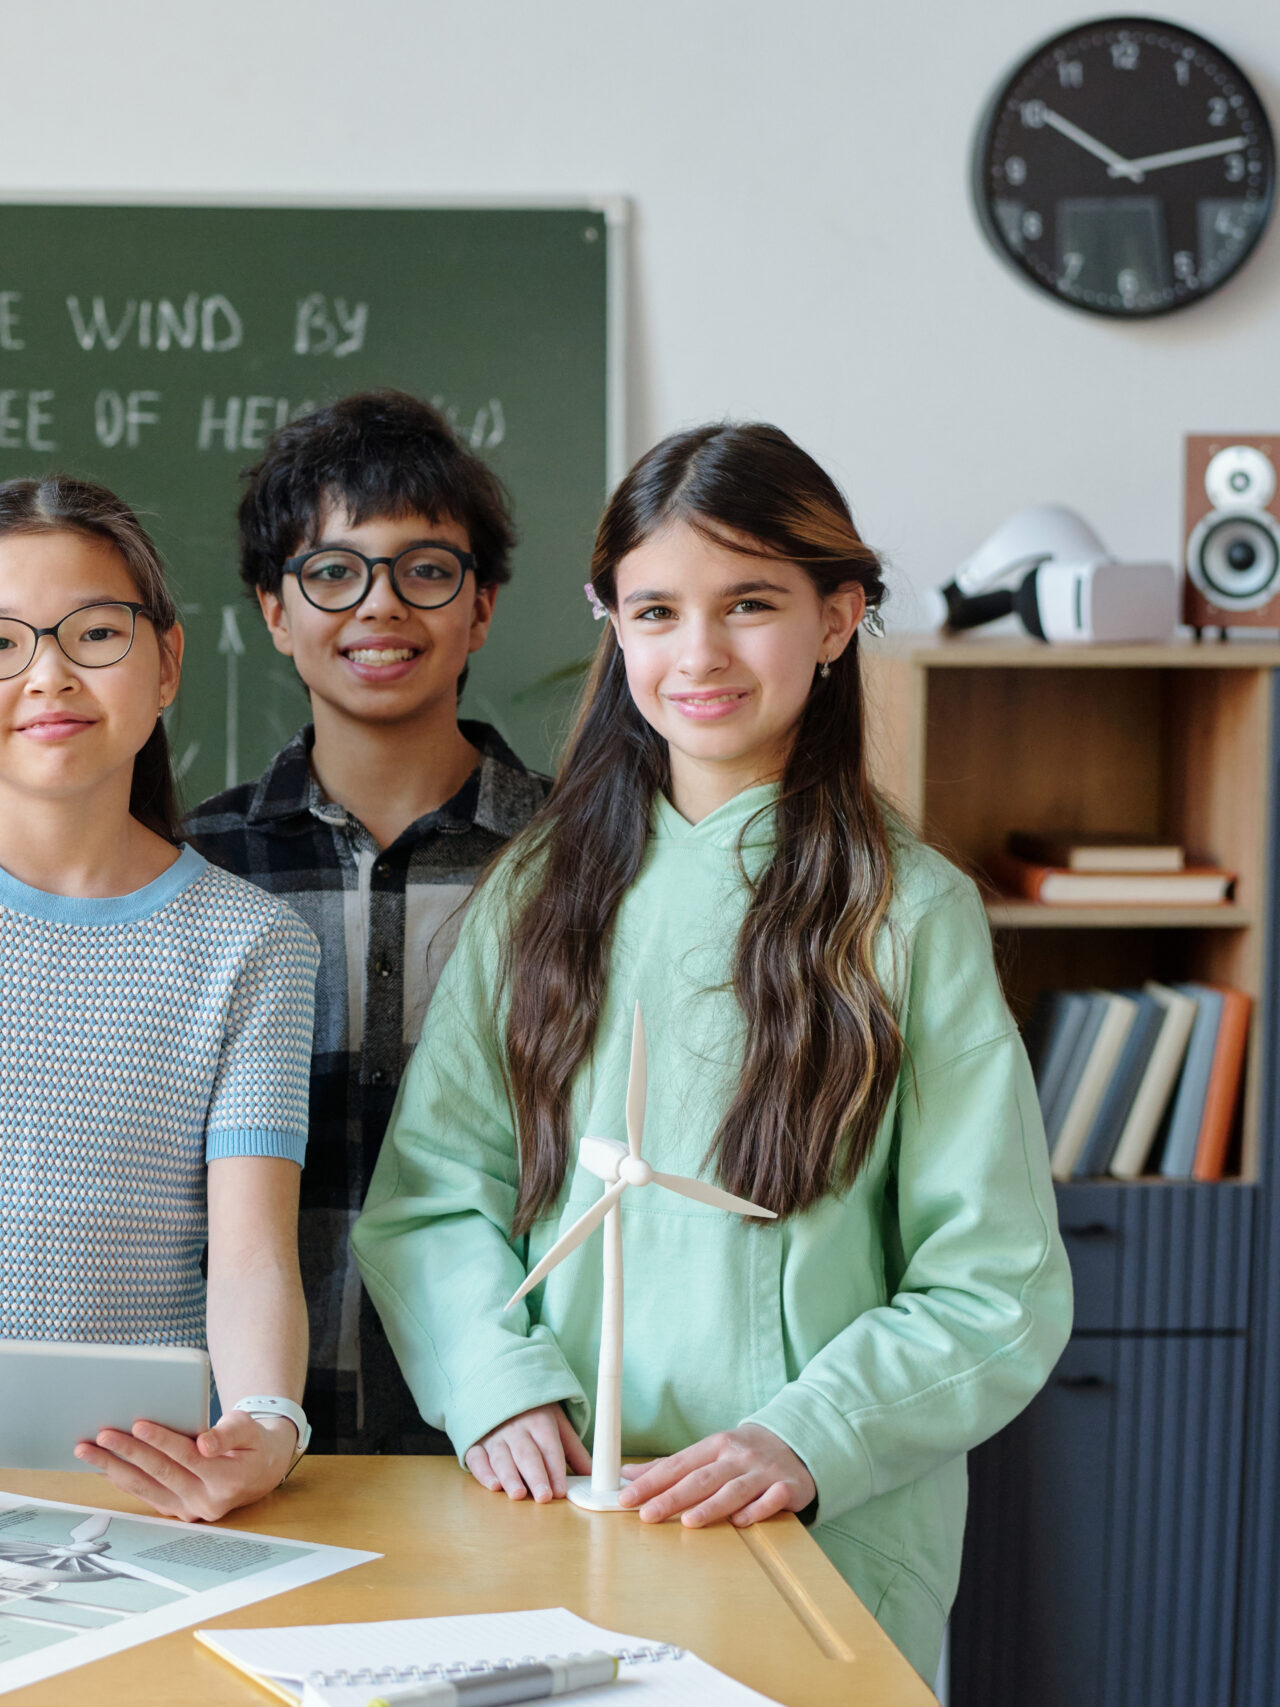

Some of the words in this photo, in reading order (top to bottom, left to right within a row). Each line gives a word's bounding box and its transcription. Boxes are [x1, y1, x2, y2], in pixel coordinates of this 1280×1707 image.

[1110, 41, 1140, 70] 12
[1058, 60, 1084, 88] 11
[1175, 60, 1190, 86] 1
[1020, 99, 1047, 128] 10
[1208, 97, 1228, 127] 2
[1005, 156, 1027, 186] 9
[1224, 153, 1245, 182] 3
[66, 291, 243, 352] WIND
[295, 292, 368, 357] BY
[95, 389, 161, 448] OF
